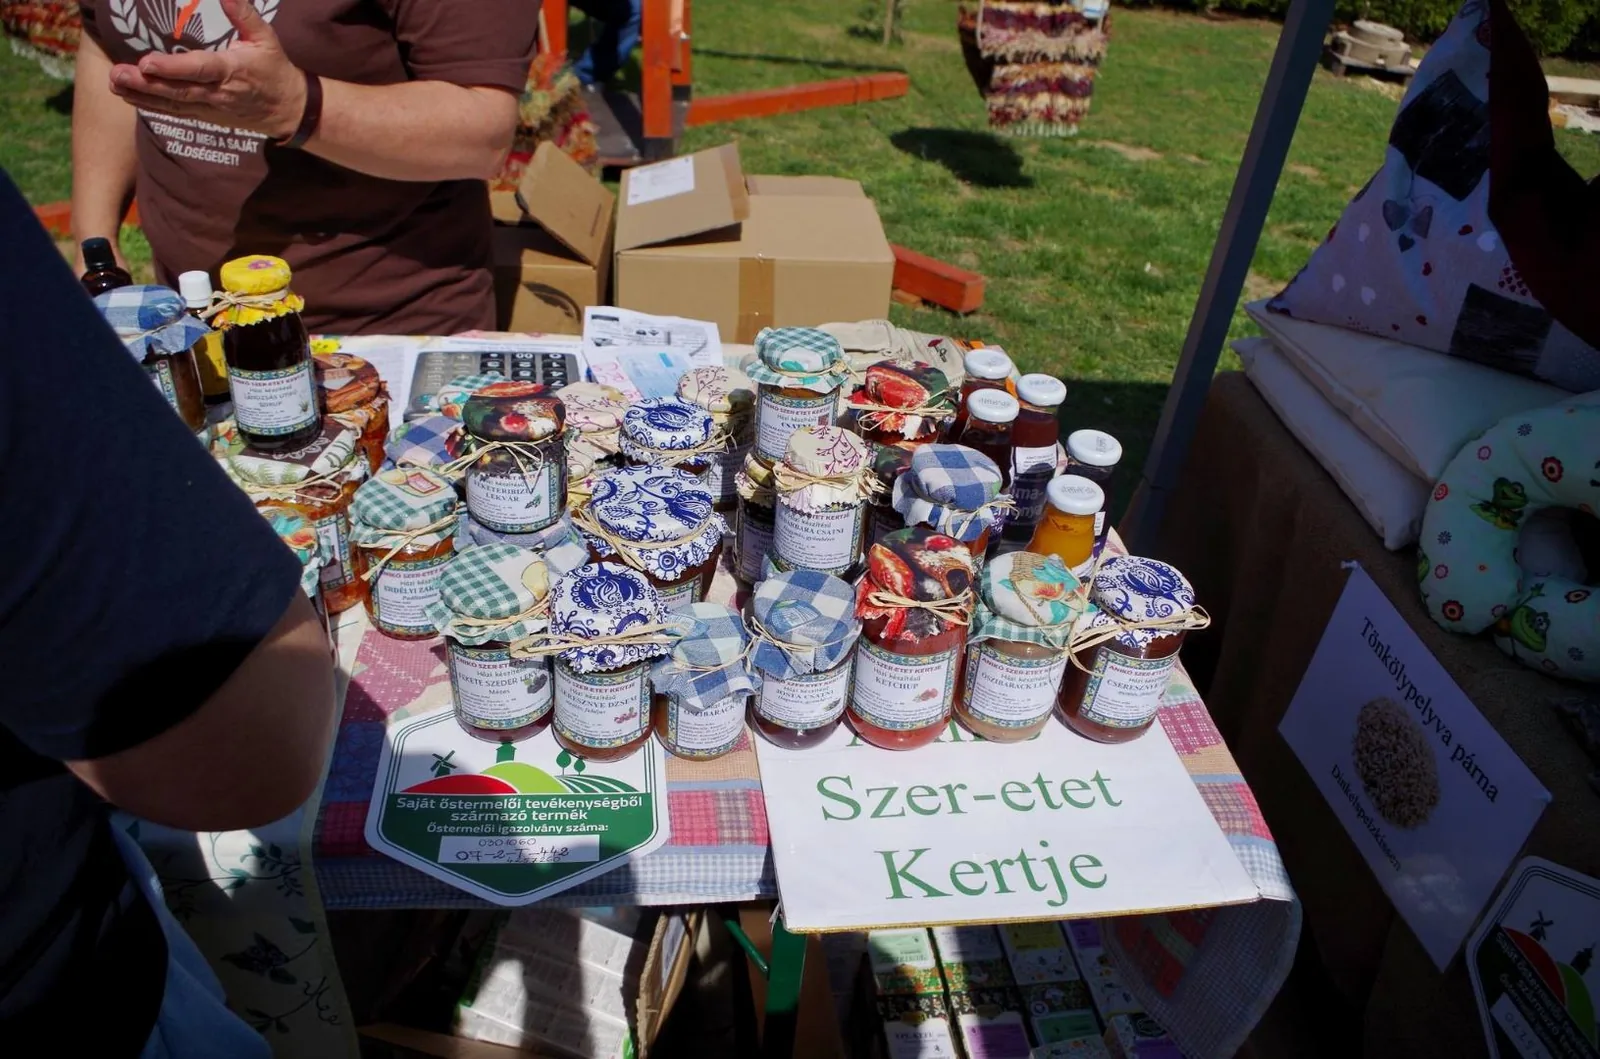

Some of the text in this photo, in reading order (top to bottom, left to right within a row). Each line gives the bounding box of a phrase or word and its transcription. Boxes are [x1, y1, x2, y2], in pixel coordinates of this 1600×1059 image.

[149, 121, 195, 143] TERMELD
[195, 132, 217, 147] MEG
[217, 137, 226, 148] A
[227, 138, 260, 153] SAJÁT
[485, 491, 520, 502] LEKVÁR
[816, 527, 844, 536] CSATNI
[384, 585, 436, 595] ERDÉLYI ZAK
[981, 657, 1005, 672] ANIKÓ
[1108, 665, 1133, 676] ANIKÓ
[458, 671, 539, 688] FEKETE SZEDER LEKV
[875, 676, 919, 690] KETCHUP
[1106, 679, 1159, 692] CSERESZNYE
[1450, 744, 1499, 804] párna
[815, 769, 1123, 822] Szer-etet
[396, 795, 643, 811] Saját őstermelői tevékenységből
[451, 809, 588, 822] származó termék
[427, 821, 495, 834] Őstermelői
[566, 823, 609, 833] száma:
[874, 840, 1108, 908] Kertje
